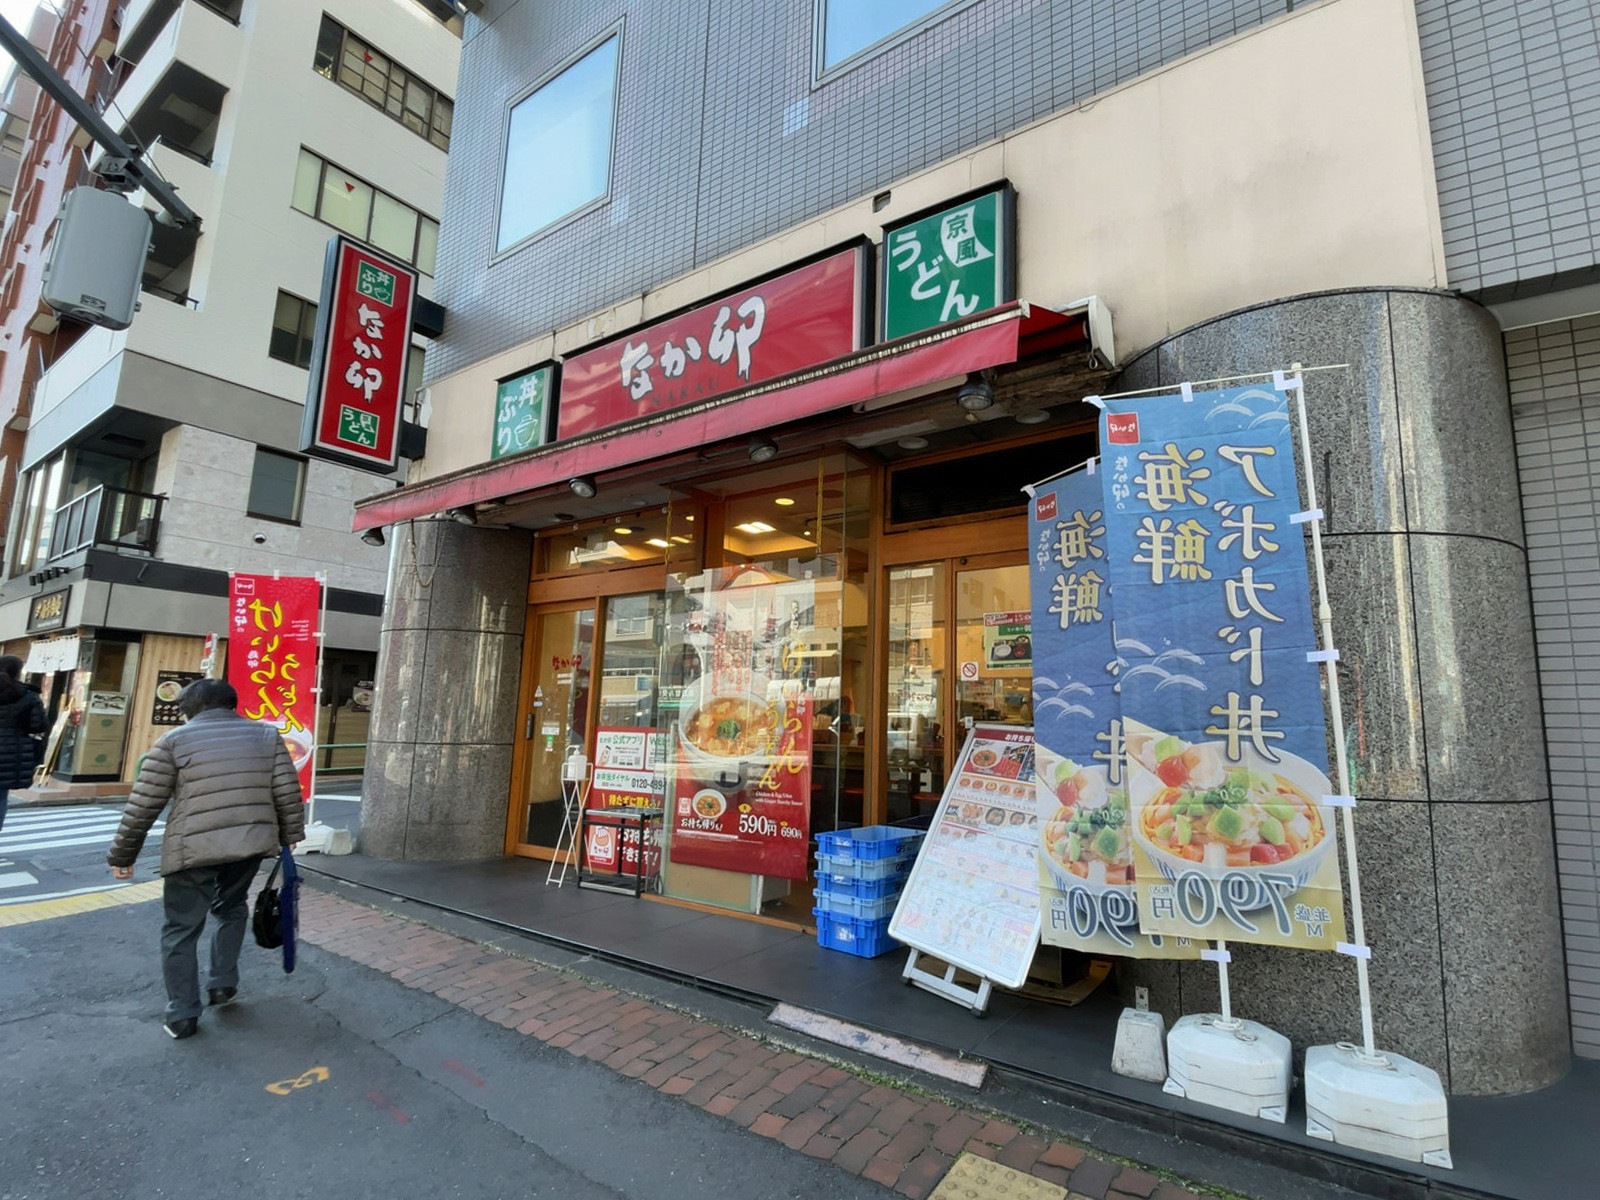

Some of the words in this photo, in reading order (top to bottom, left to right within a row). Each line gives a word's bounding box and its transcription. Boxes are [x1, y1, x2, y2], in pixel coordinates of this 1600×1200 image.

[946, 214, 978, 264] 京風
[891, 229, 980, 322] うどん
[345, 302, 385, 404] なか卯
[619, 295, 766, 401] なか卯
[343, 408, 371, 445] うどん
[552, 655, 582, 671] なか卯
[739, 814, 777, 837] 590円
